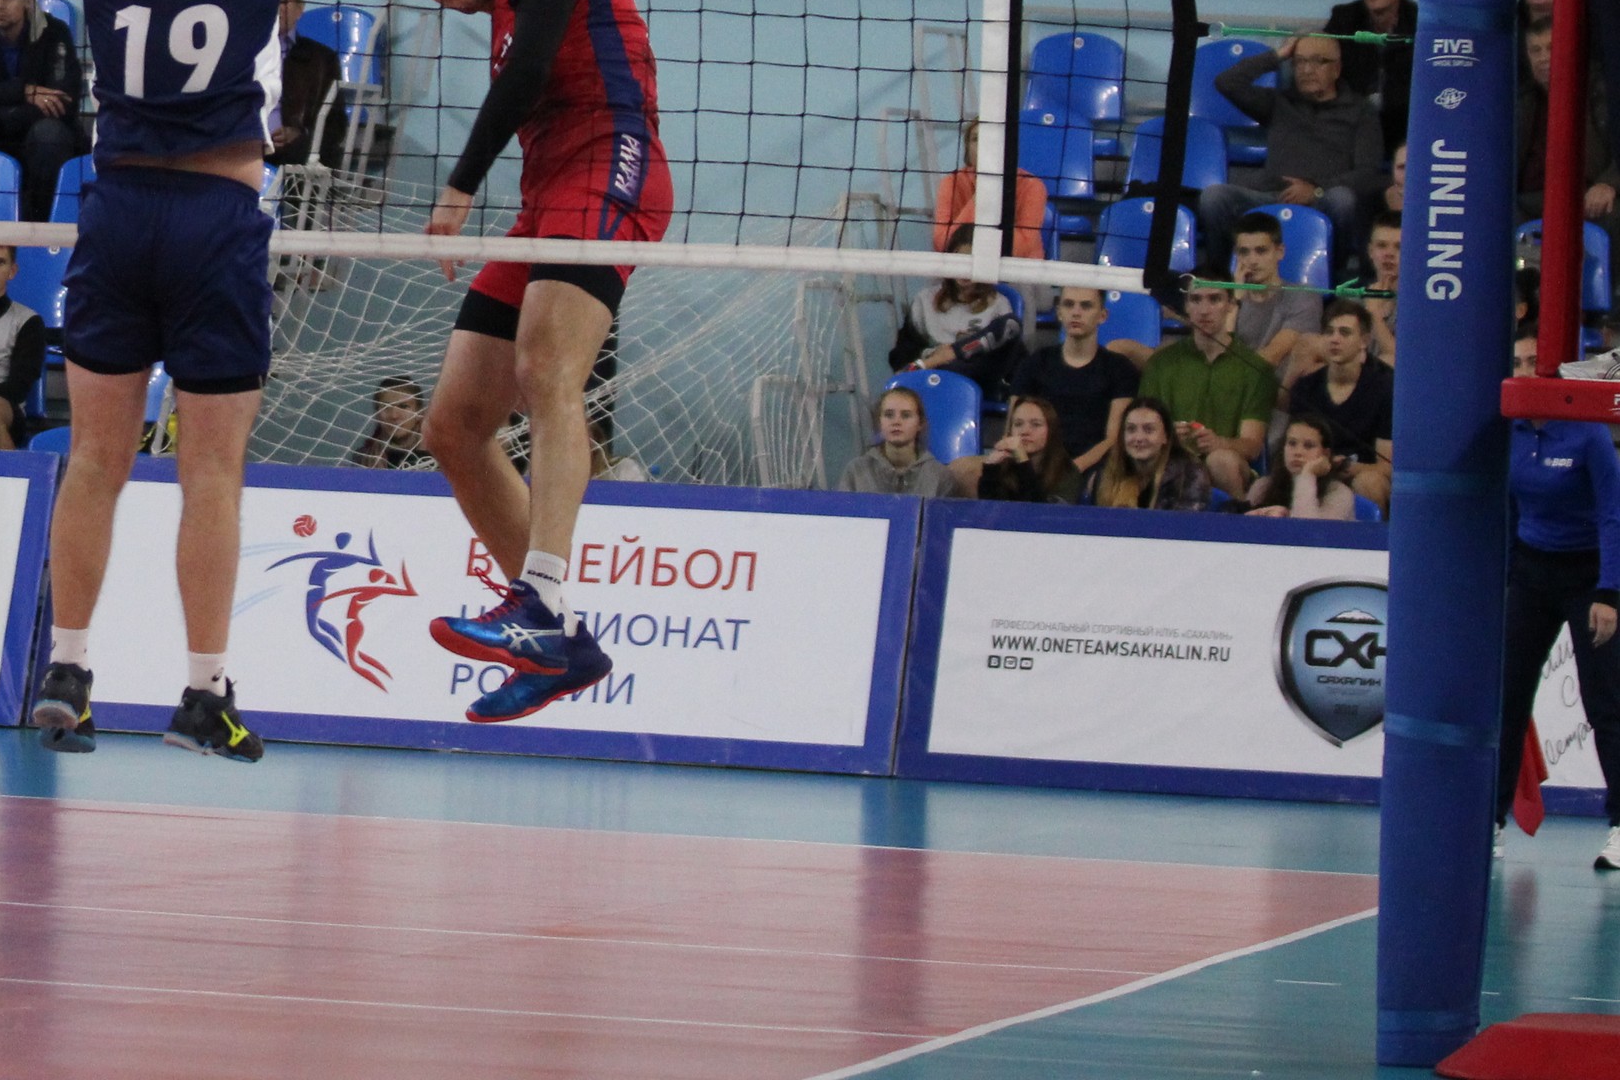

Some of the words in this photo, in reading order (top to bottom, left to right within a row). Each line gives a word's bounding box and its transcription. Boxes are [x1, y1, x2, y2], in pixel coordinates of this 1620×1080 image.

[113, 3, 229, 99] 19
[1433, 39, 1474, 53] FIVB
[614, 133, 641, 197] КАМА
[1425, 139, 1467, 301] JINLING
[466, 535, 757, 591] ВЕЙБОЛ
[991, 618, 1090, 633] ПРОФЕССИОНАЛЬНЫЙ
[1091, 623, 1154, 637] СПОРТИВНЫЙ
[991, 634, 1231, 662] WWW.ONETEAMSAKHALIN.RU
